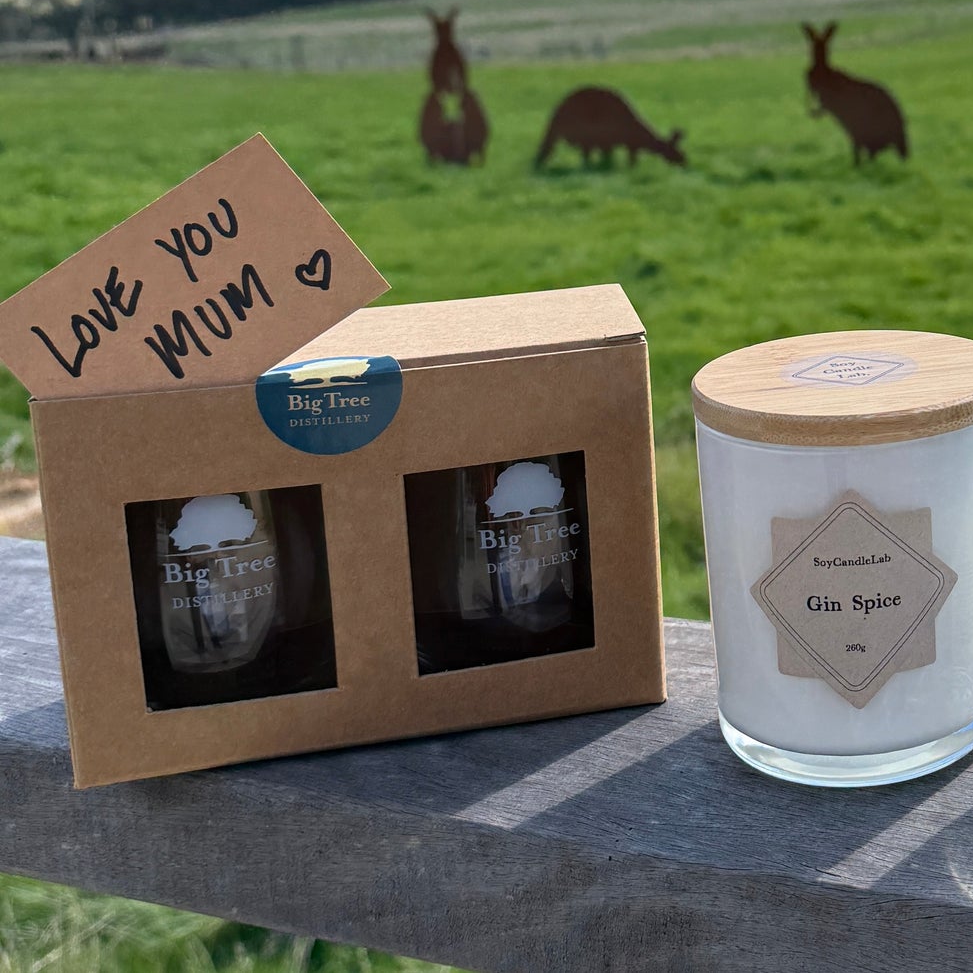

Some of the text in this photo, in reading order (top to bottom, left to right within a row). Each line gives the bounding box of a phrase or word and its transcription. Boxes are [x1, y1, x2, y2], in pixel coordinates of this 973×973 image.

[31, 198, 239, 377] LOVE YOU
[144, 264, 274, 379] MUM
[287, 391, 371, 416] Big Tree
[289, 413, 371, 428] DISTILLERY
[478, 521, 581, 555] Big Tree
[162, 554, 277, 589] Big Tree
[487, 548, 579, 575] DISTILLERY
[813, 552, 892, 570] SoyCandleLab
[171, 581, 275, 610] DISTILLERY
[806, 592, 902, 615] Gin Spice
[845, 643, 867, 653] 260g
